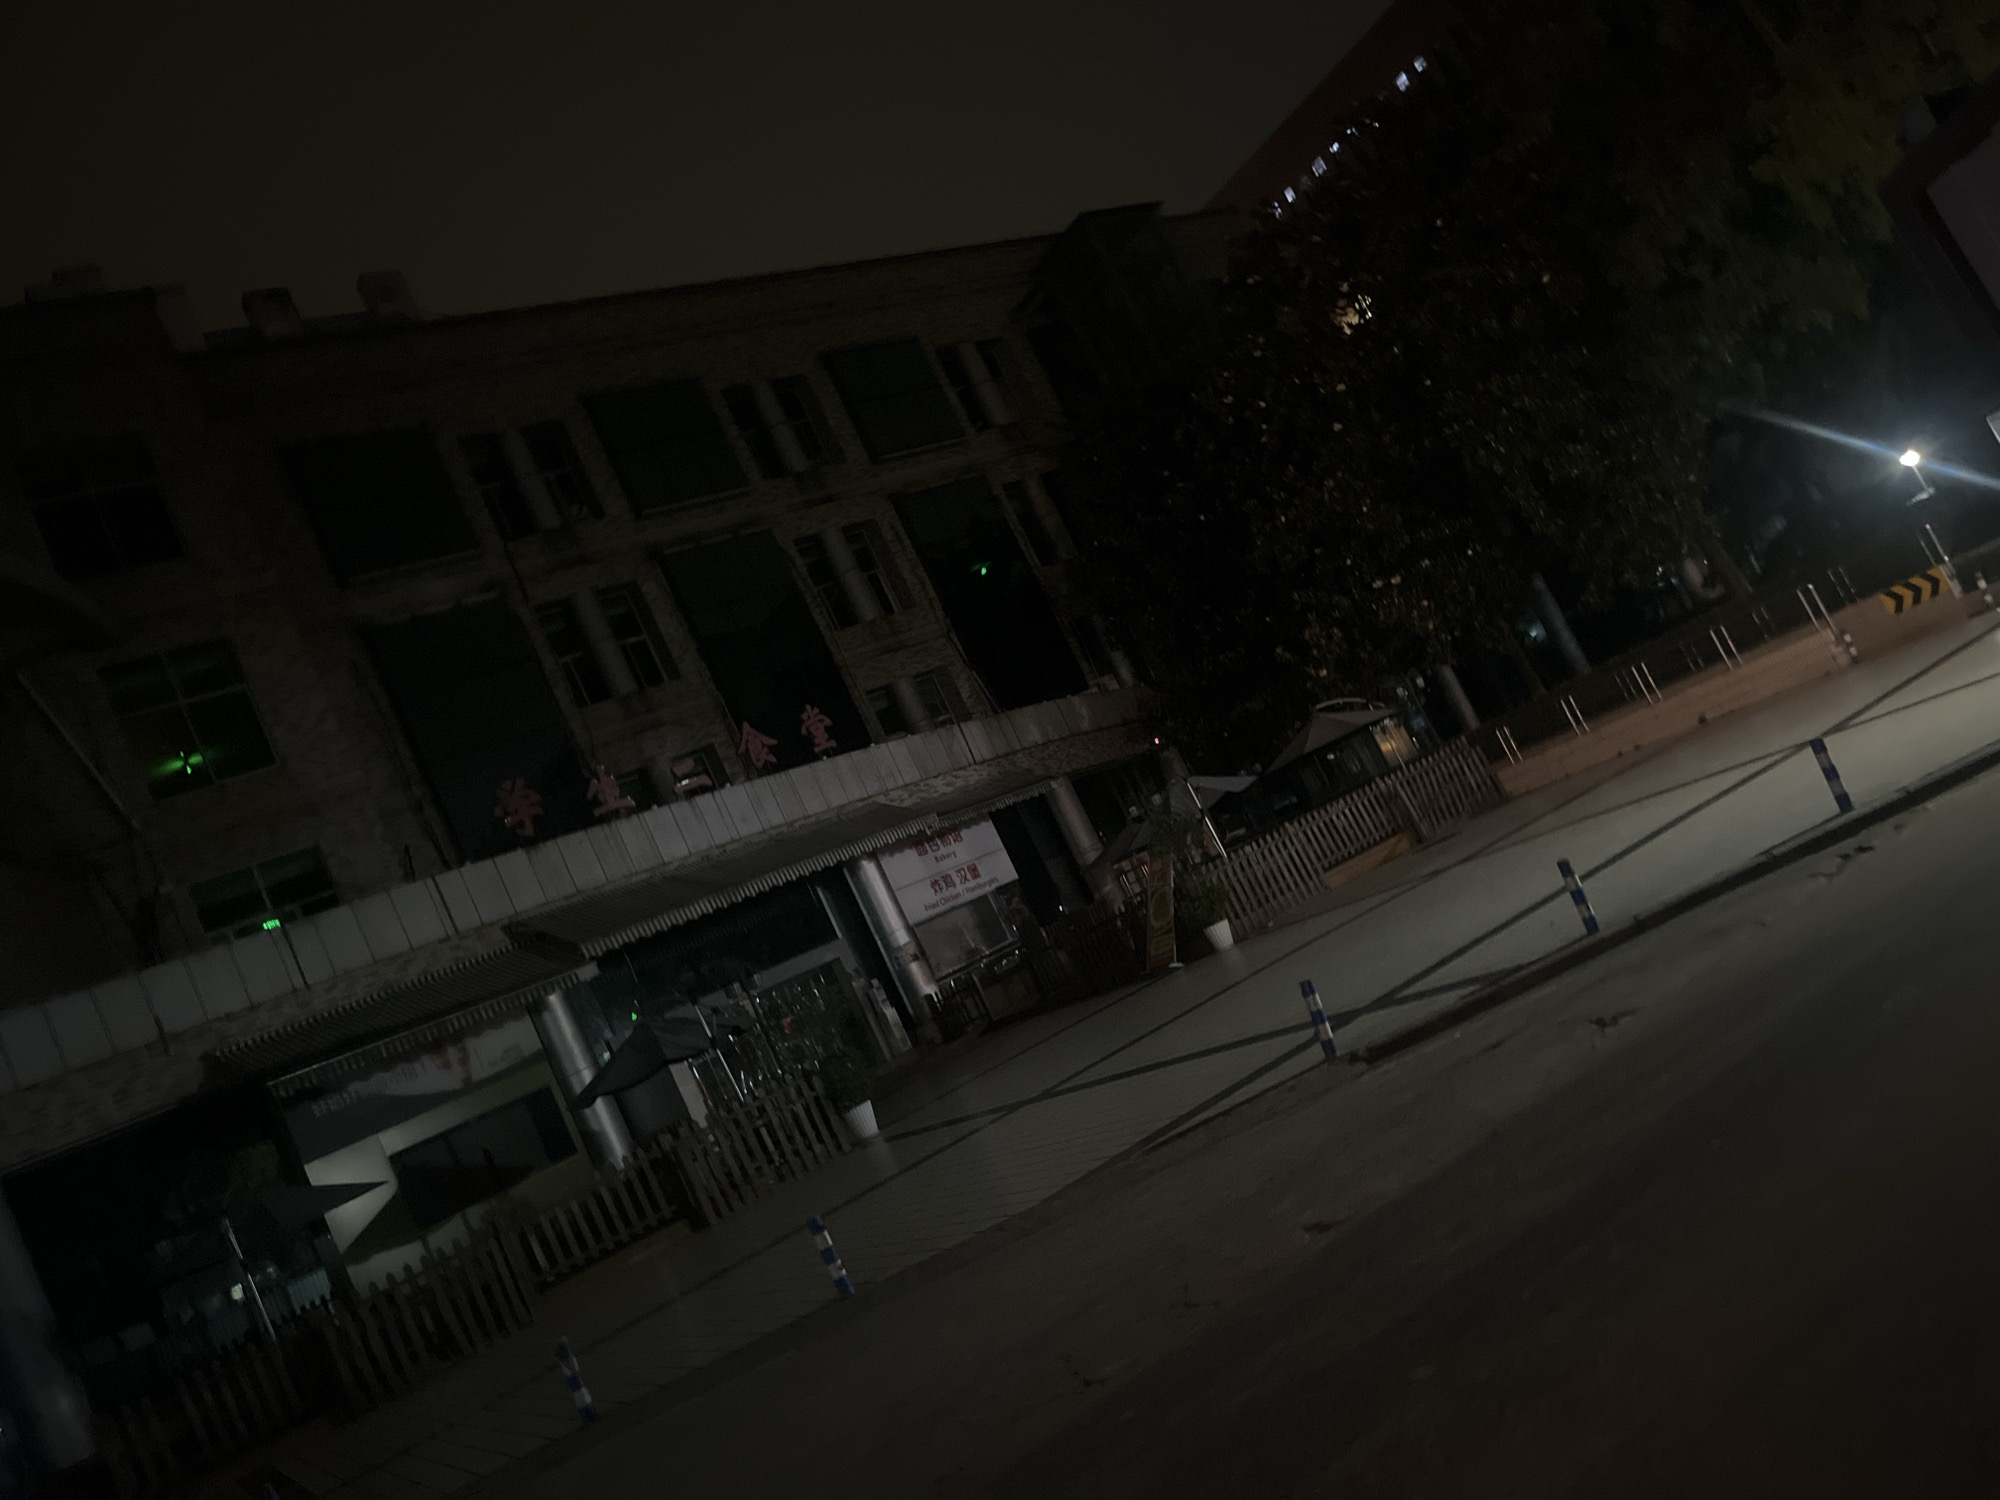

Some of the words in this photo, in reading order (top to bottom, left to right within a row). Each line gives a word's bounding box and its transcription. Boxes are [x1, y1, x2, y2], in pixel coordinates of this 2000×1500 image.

[934, 851, 957, 862] Bakery
[929, 873, 956, 895] 炸鸡
[955, 863, 981, 884] 汉堡
[924, 900, 939, 911] Fried
[939, 892, 961, 905] Chicken
